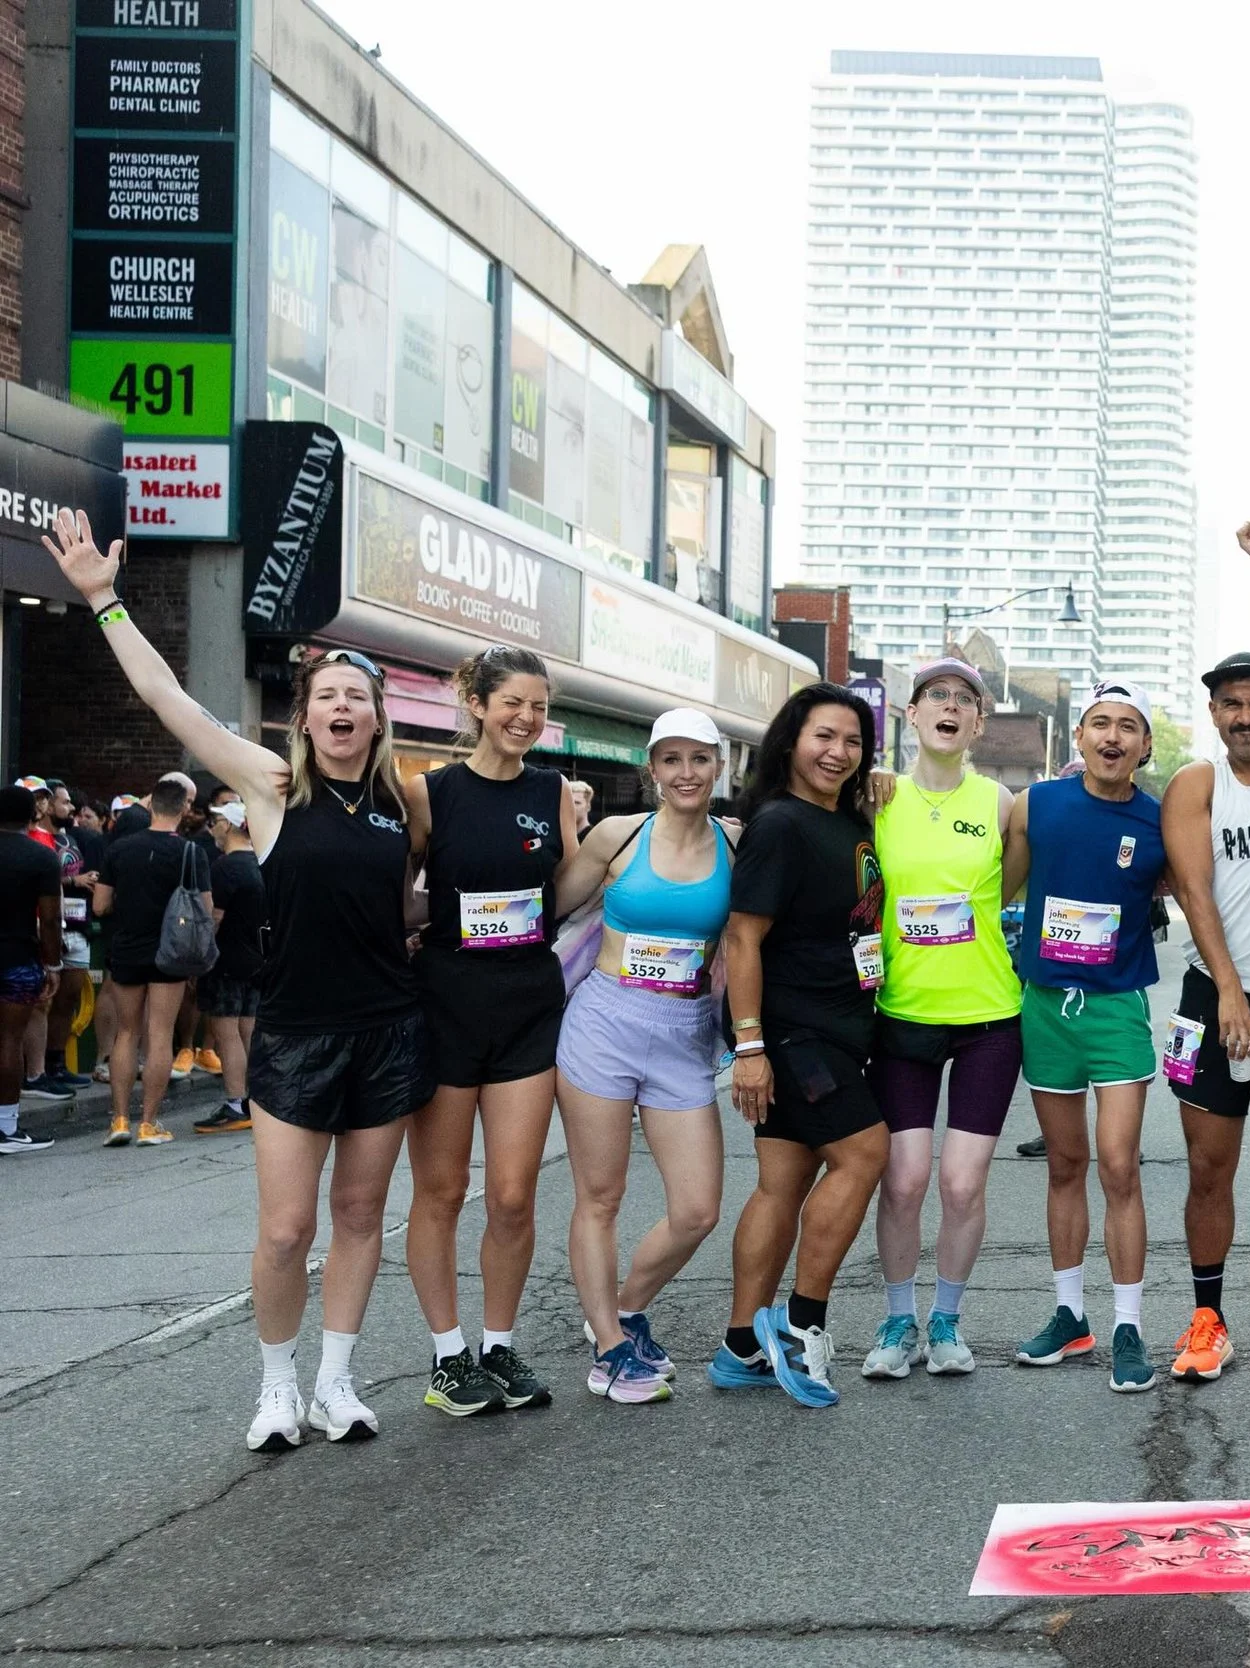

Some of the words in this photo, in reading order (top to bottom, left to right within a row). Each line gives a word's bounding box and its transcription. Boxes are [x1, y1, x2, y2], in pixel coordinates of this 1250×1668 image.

[113, 0, 200, 27] HEALTH
[110, 59, 148, 73] FAMILY
[151, 62, 201, 74] DOCTORS
[110, 76, 200, 95] PHARMACY
[110, 97, 156, 112] DENTAL
[159, 100, 201, 113] CLINIC
[109, 152, 200, 166] PHYSIOTHERAPY
[109, 166, 200, 180] CHIROPRACTIC
[109, 180, 153, 190] MASSAGE
[157, 181, 199, 192] THERAPY
[109, 191, 199, 205] ACUPUNCTURE
[108, 204, 200, 222] ORTHOTICS
[272, 211, 318, 298] CW
[110, 256, 195, 282] CHURCH
[110, 284, 194, 303] WELLESLEY
[109, 305, 149, 319] HEALTH
[153, 306, 194, 320] CENTRE
[109, 362, 194, 416] 491
[511, 372, 539, 432] CW
[140, 480, 221, 498] Market
[129, 506, 176, 525] Ltd.
[247, 432, 338, 622] BYZANTIUM
[419, 513, 493, 592] GLAD
[495, 544, 542, 611] DAY
[416, 580, 451, 611] BOOKS
[459, 595, 493, 625] COFFEE
[500, 608, 541, 641] COCKTAILS
[467, 905, 498, 914] rachel
[901, 908, 914, 918] lily
[1048, 909, 1068, 919] john
[469, 921, 508, 936] 3526
[904, 924, 939, 936] 3525
[1048, 926, 1081, 942] 3797
[630, 948, 661, 958] sophie
[628, 963, 666, 980] 3529
